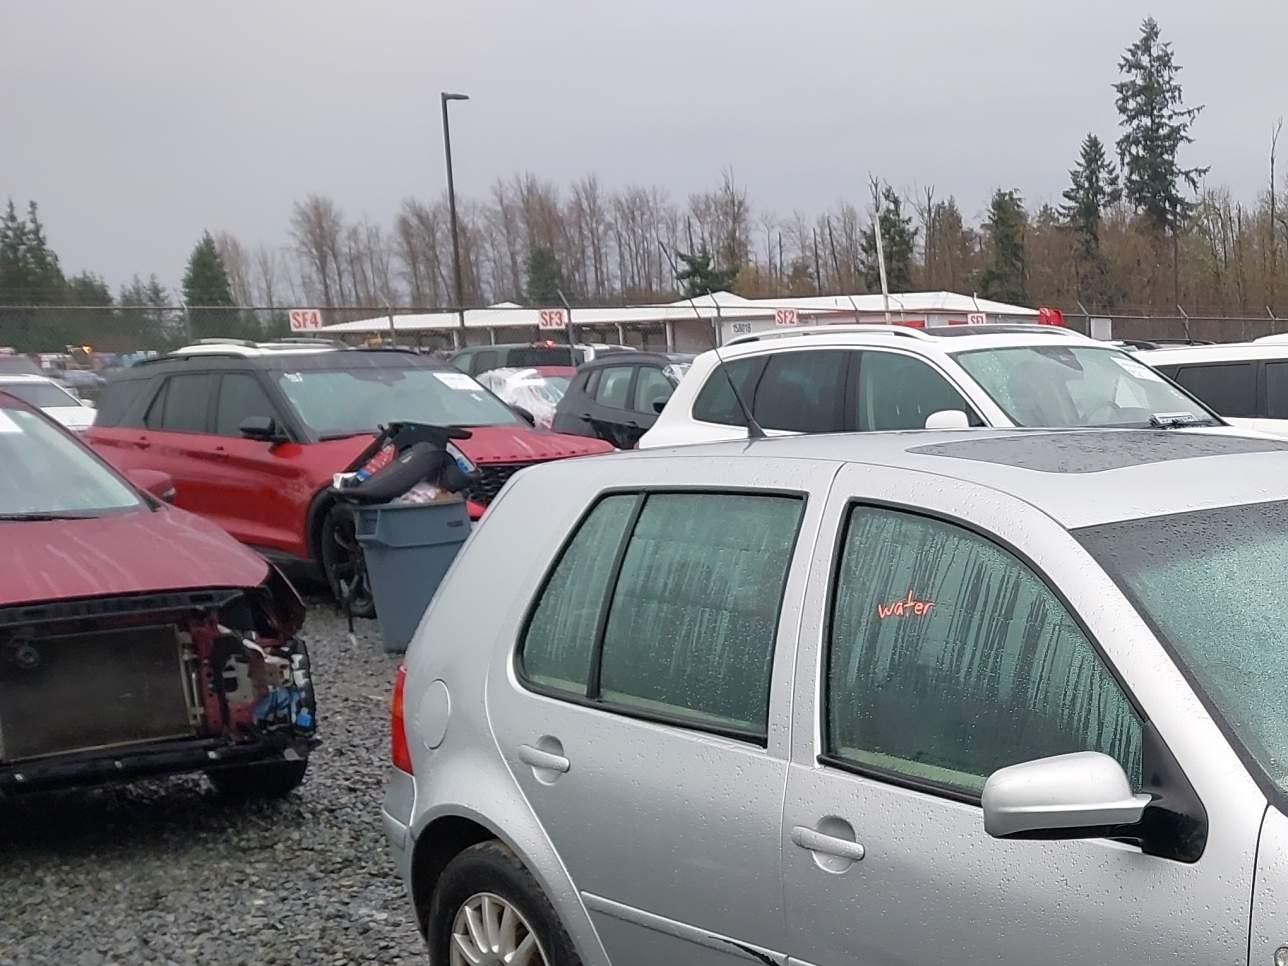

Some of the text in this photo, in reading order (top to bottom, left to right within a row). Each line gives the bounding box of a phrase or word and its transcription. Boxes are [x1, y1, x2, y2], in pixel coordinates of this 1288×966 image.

[292, 311, 320, 329] SF4
[540, 311, 562, 327] SF3
[777, 310, 795, 324] SF2
